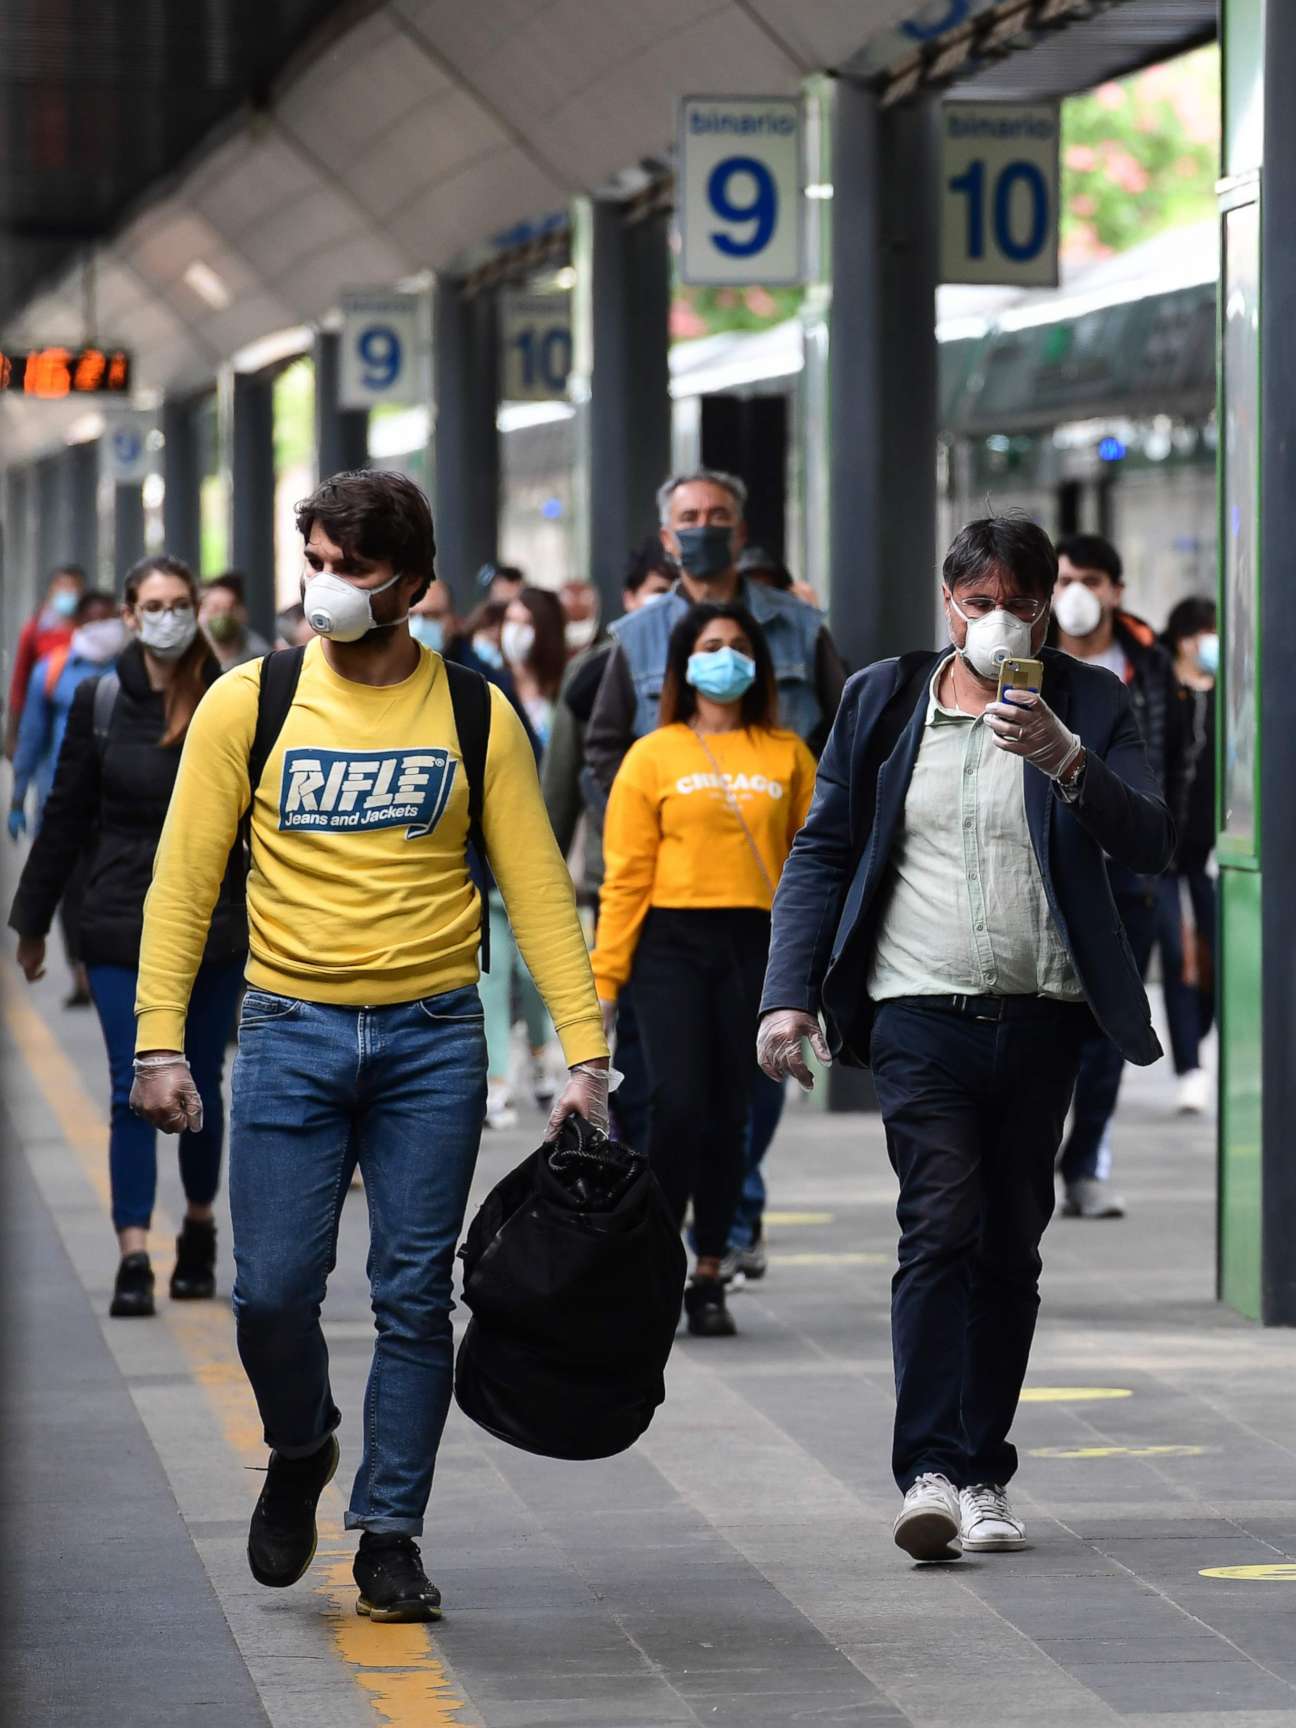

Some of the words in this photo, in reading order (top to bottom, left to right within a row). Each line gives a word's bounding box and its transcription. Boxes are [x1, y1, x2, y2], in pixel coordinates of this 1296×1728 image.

[689, 111, 795, 136] binario
[707, 155, 778, 259] 9
[949, 158, 1049, 263] 10
[358, 322, 402, 390] 9
[516, 324, 573, 390] 10
[285, 812, 327, 826] Jeans
[330, 812, 358, 825] and
[361, 804, 418, 824] Jackets
[676, 773, 782, 800] CHICAGO
